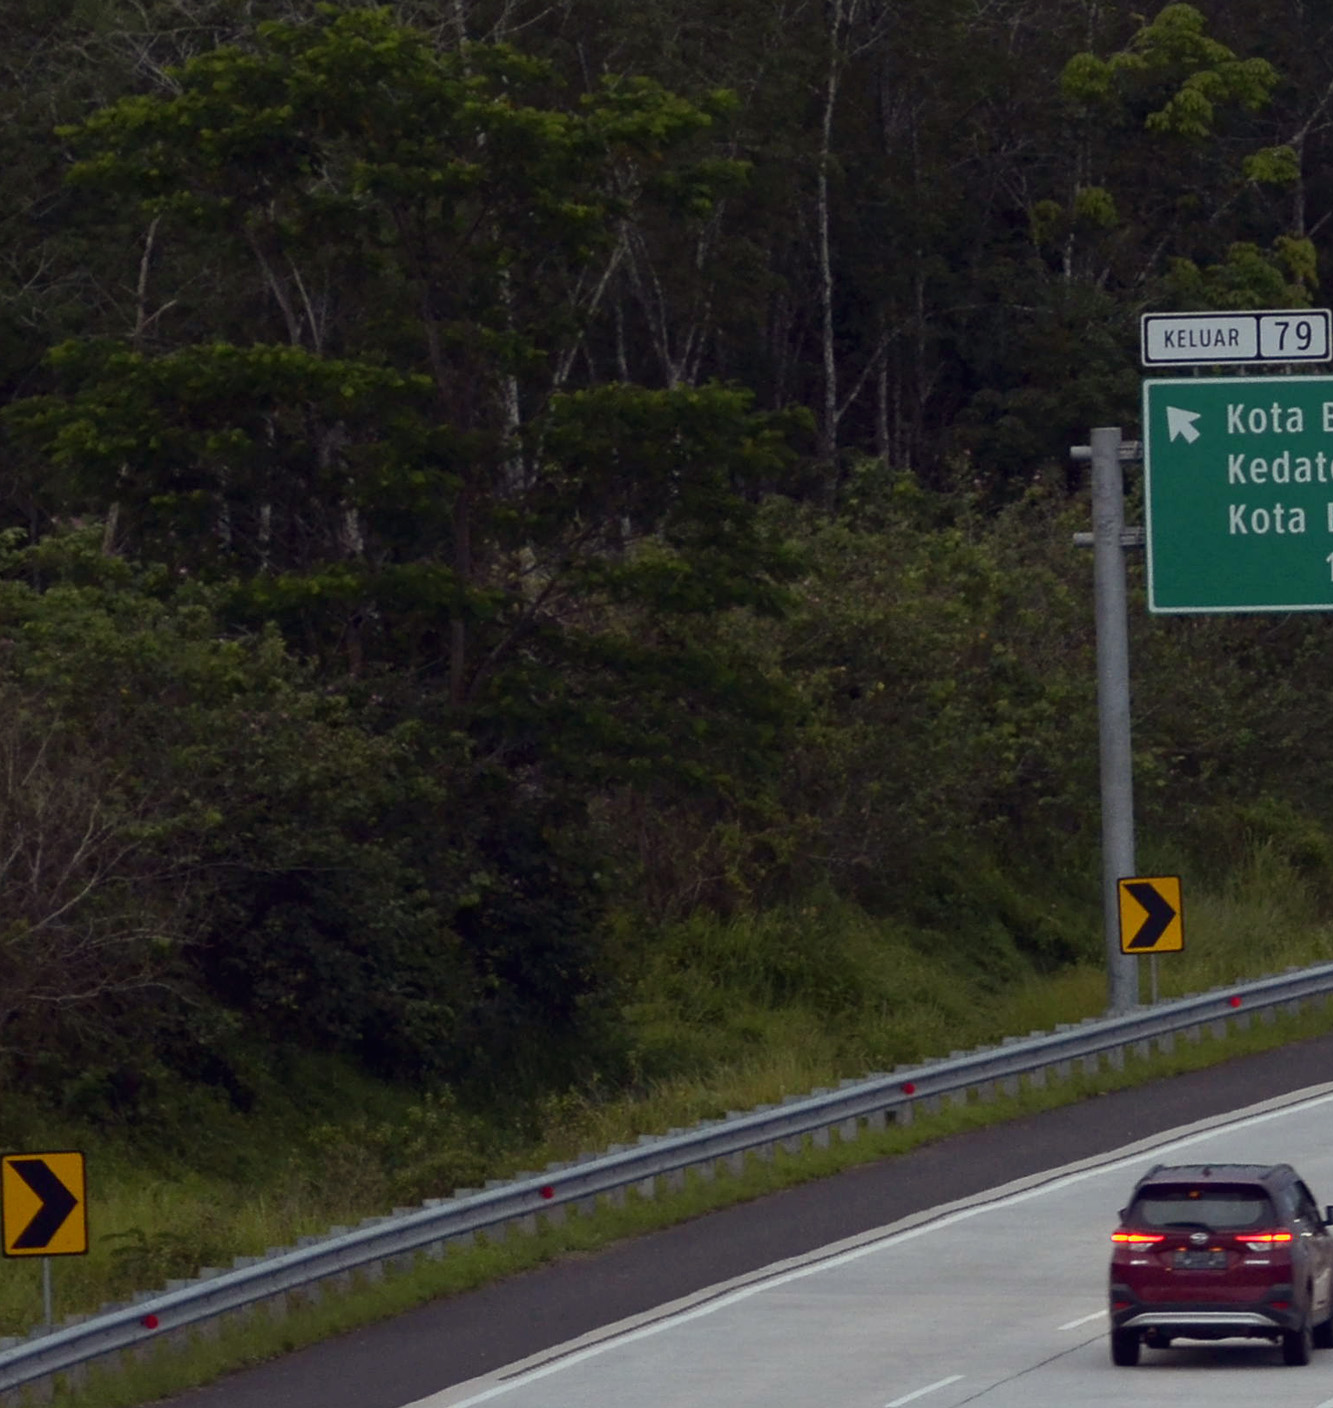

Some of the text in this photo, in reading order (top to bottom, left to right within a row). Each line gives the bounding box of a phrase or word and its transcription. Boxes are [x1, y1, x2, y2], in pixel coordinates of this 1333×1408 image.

[1164, 320, 1312, 351] KELUAR 79
[1227, 401, 1304, 435] Kota
[1229, 502, 1306, 535] Kota
